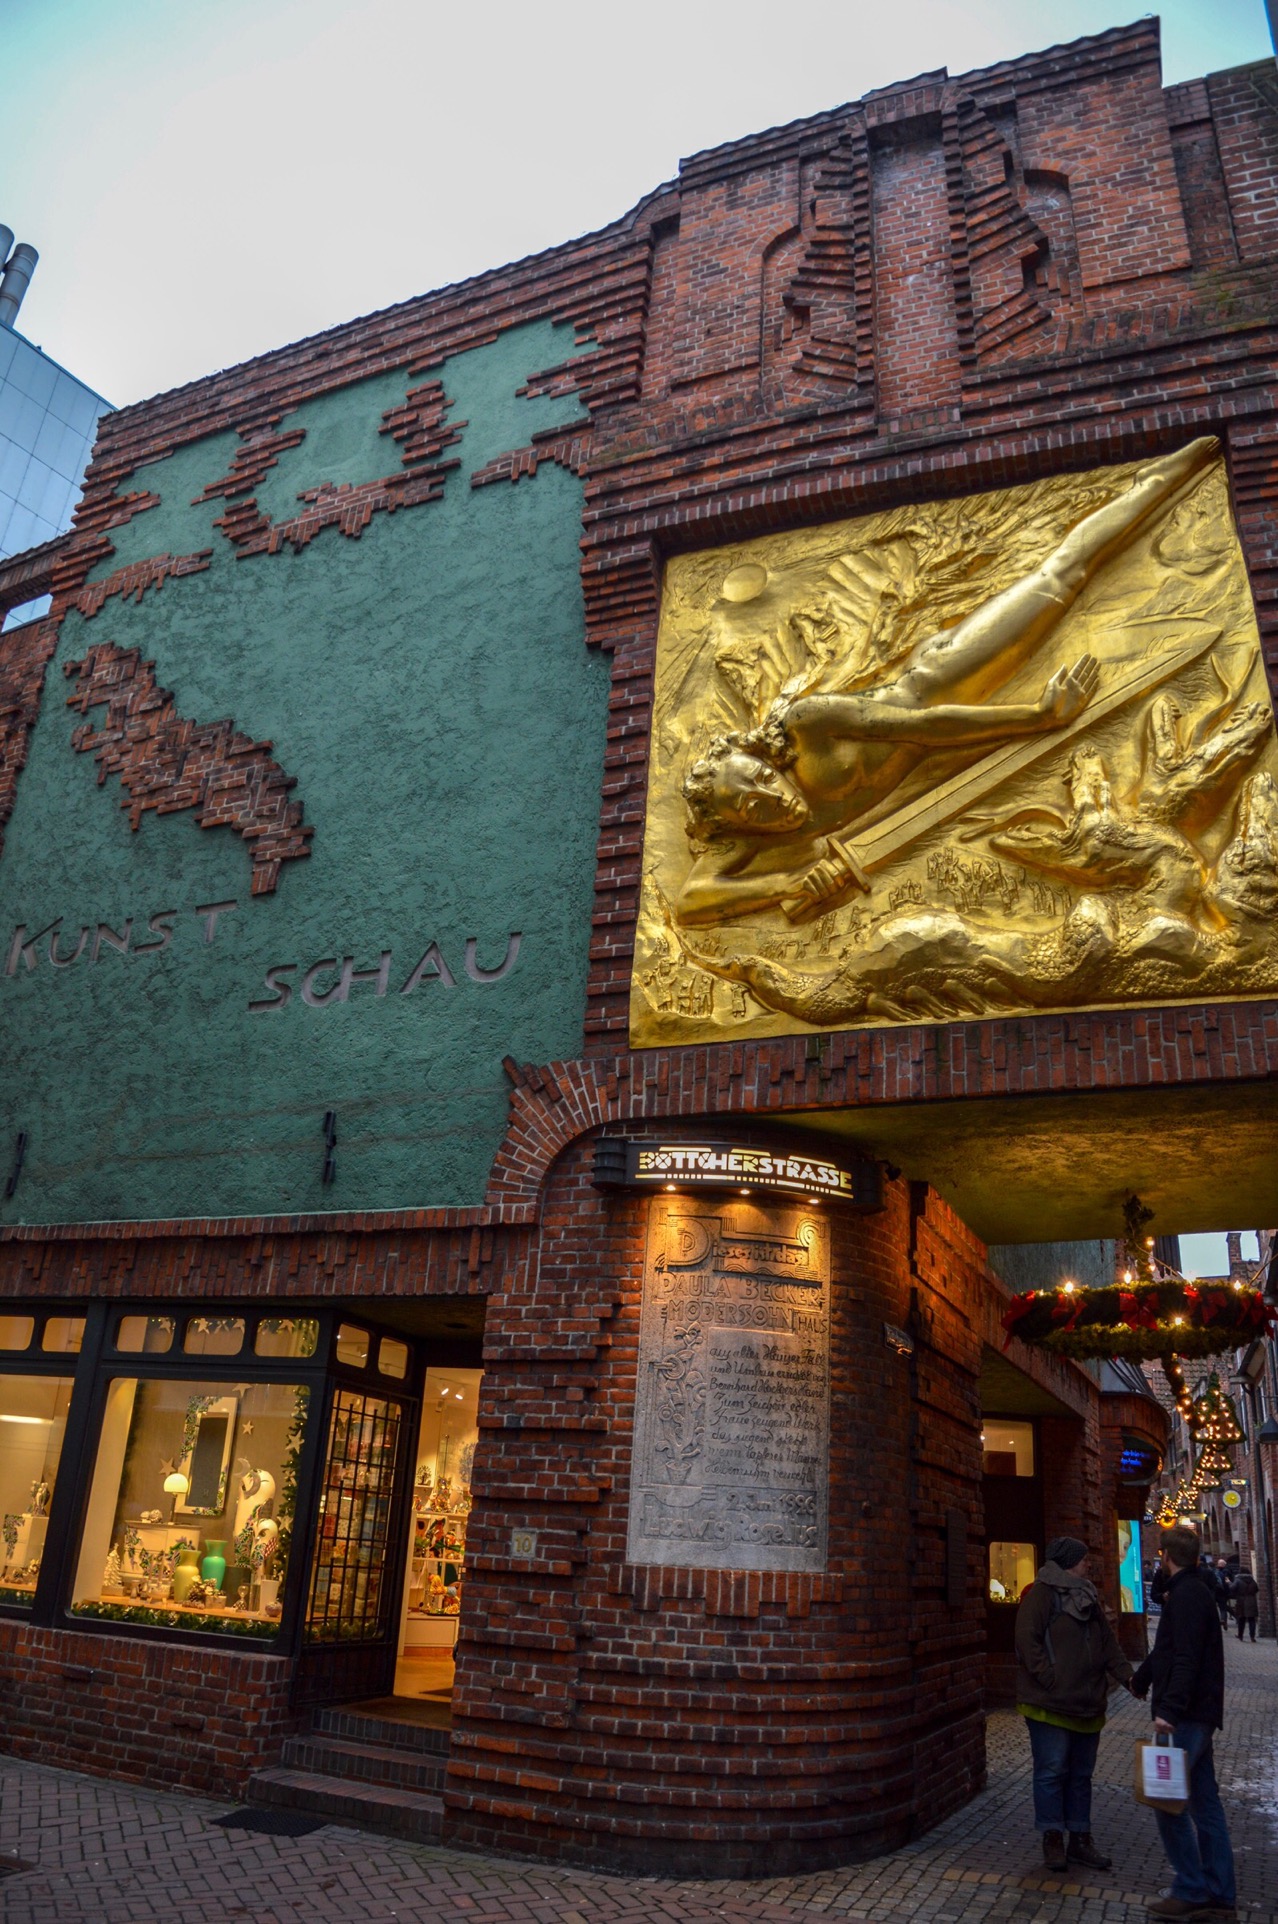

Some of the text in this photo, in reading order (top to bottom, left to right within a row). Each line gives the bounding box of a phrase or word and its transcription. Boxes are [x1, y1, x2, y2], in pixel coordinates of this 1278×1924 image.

[4, 899, 237, 976] KUNST
[248, 931, 523, 1012] SCHAU
[657, 1271, 731, 1299] PAULA
[668, 1299, 829, 1334] MODERSOHN HAUS
[709, 1361, 733, 1375] und
[709, 1377, 756, 1394] Bernhard
[708, 1446, 741, 1459] wenn
[643, 1505, 818, 1551] Ludwig Roselius
[514, 1534, 532, 1553] 10
